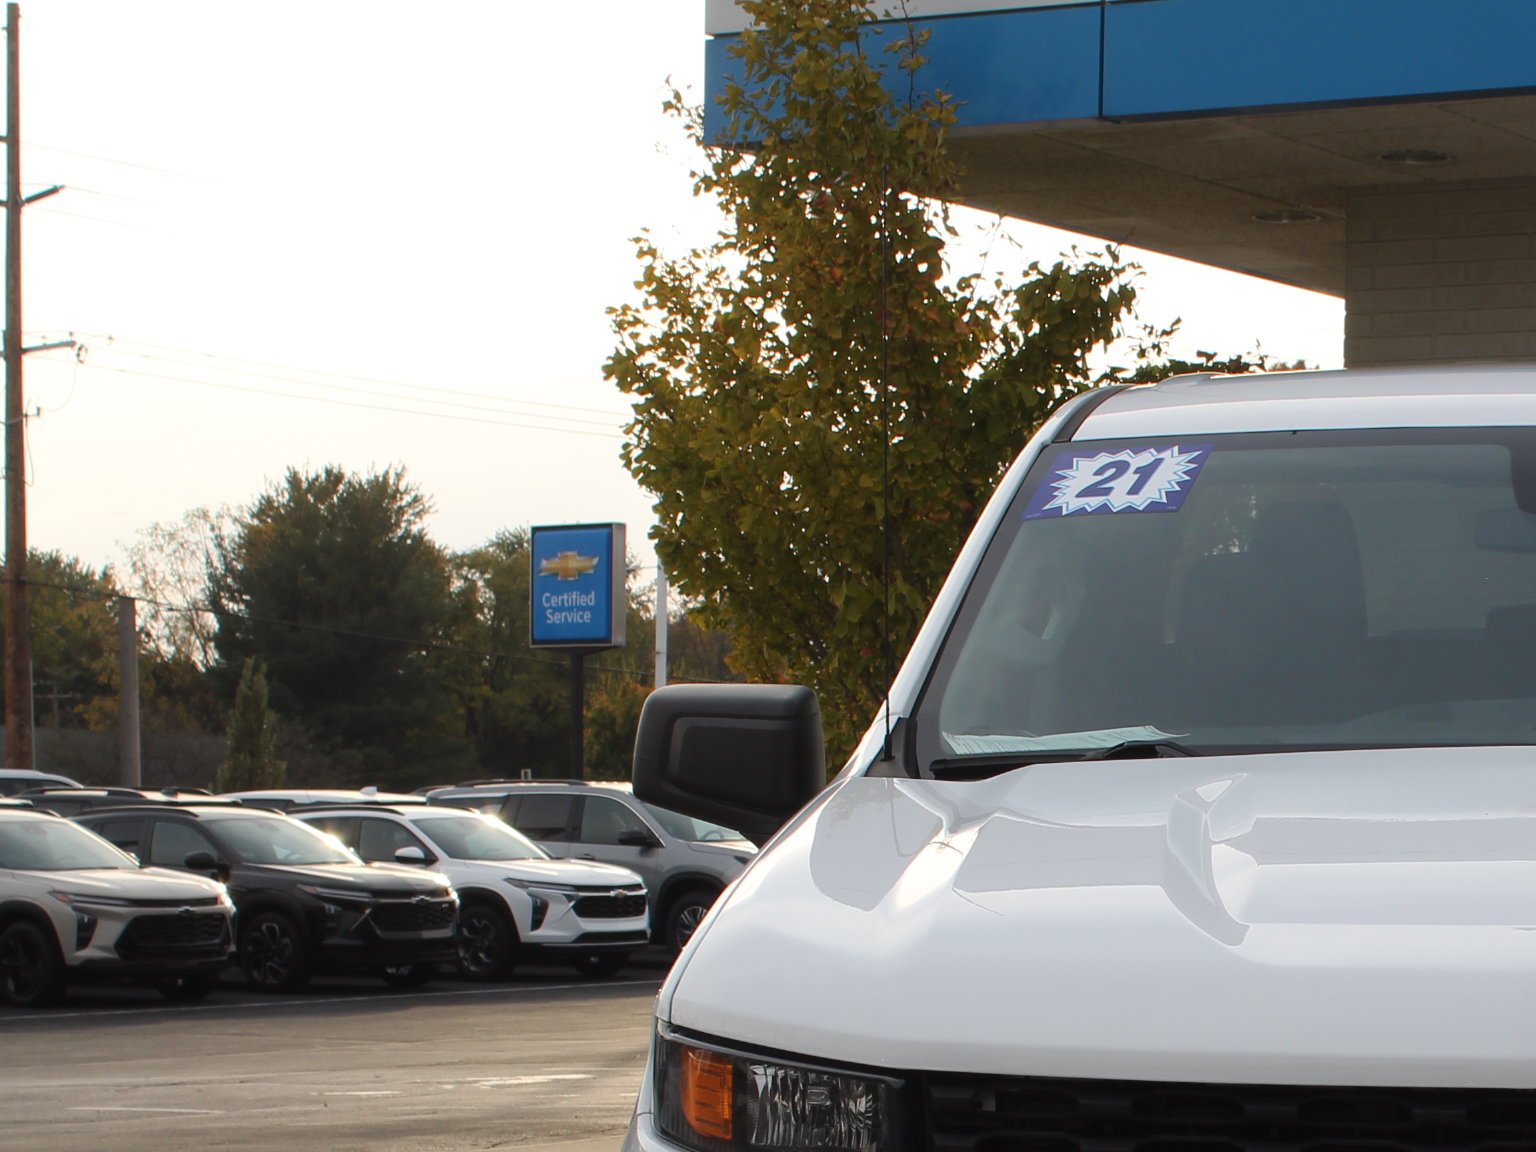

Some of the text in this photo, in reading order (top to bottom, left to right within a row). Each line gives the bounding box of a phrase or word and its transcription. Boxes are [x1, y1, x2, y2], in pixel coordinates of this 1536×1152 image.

[1074, 456, 1166, 499] 21
[541, 591, 596, 608] Certified
[545, 608, 592, 624] Service
